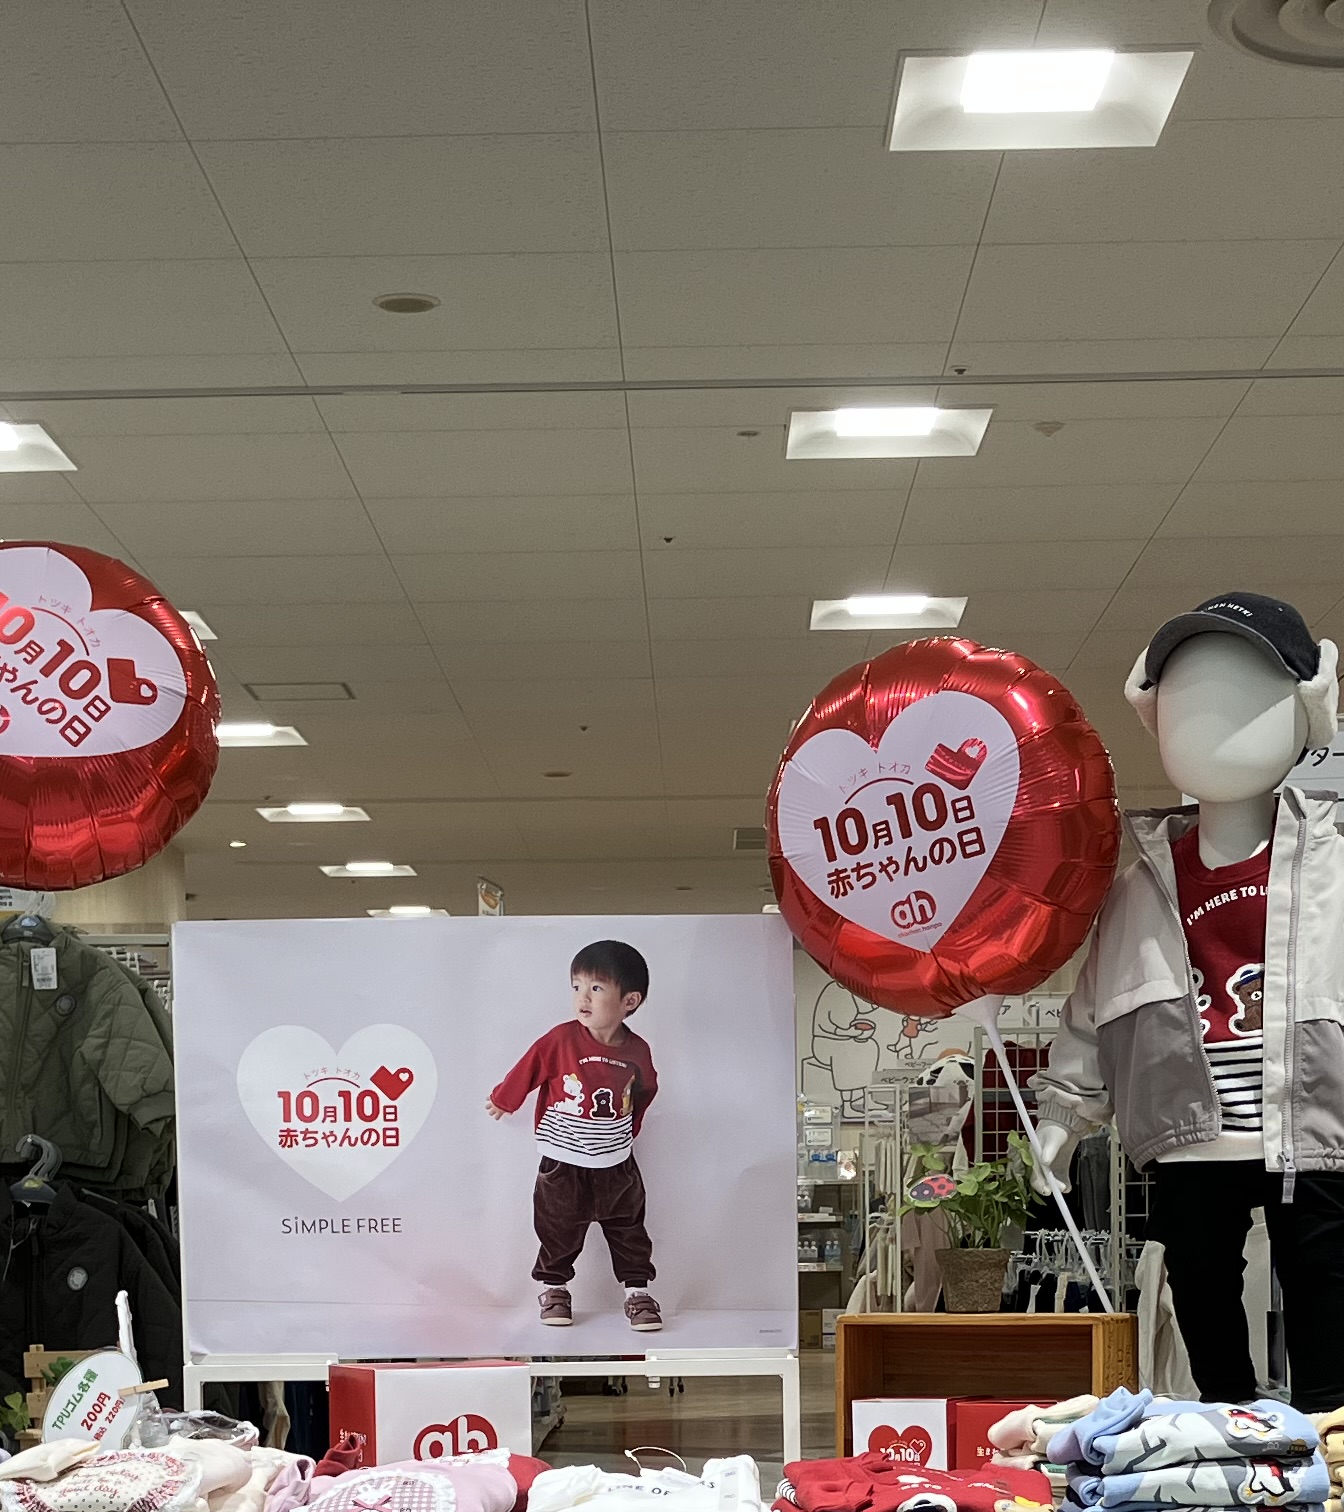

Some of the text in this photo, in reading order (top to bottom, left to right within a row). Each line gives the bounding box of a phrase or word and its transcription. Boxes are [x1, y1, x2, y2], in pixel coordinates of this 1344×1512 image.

[813, 782, 975, 863] 10月10日
[827, 826, 986, 899] 赤ちゃんの日
[1186, 885, 1257, 926] I'M HERE TO
[277, 1089, 398, 1124] 10月10日
[278, 1127, 400, 1149] 赤ちゃんの日
[357, 1217, 402, 1234] FREE
[81, 1392, 111, 1431] 200円
